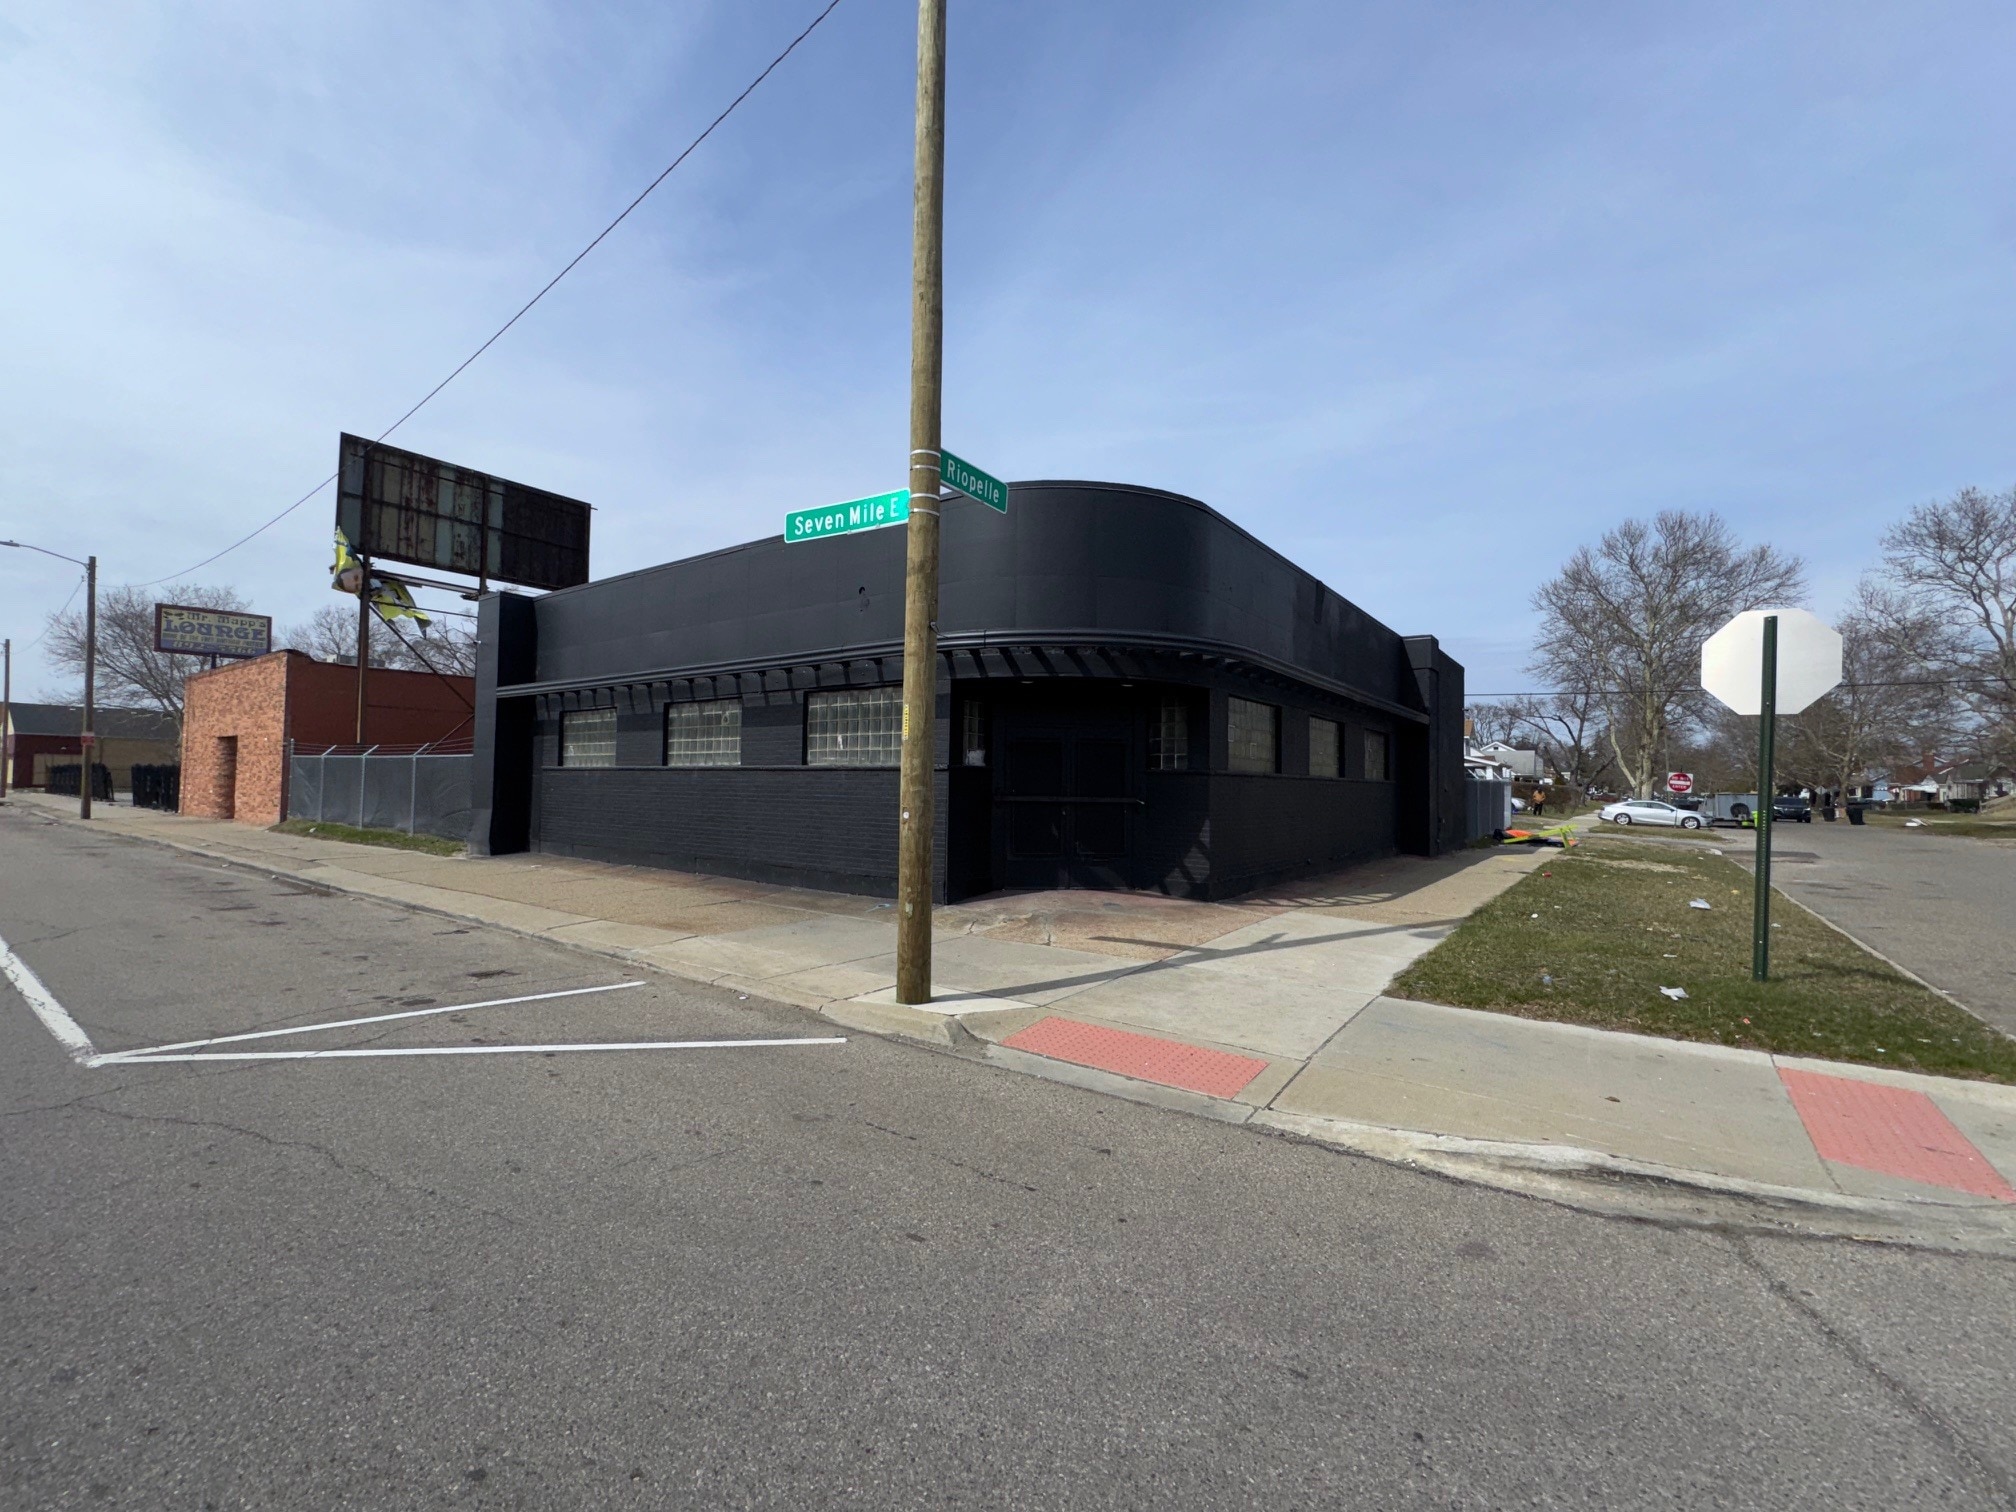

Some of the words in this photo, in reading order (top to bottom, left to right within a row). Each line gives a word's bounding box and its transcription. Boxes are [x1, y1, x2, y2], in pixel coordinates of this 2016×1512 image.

[947, 459, 999, 503] Riopelle
[794, 513, 844, 536] Seven
[849, 502, 885, 526] Mile
[890, 497, 899, 518] E
